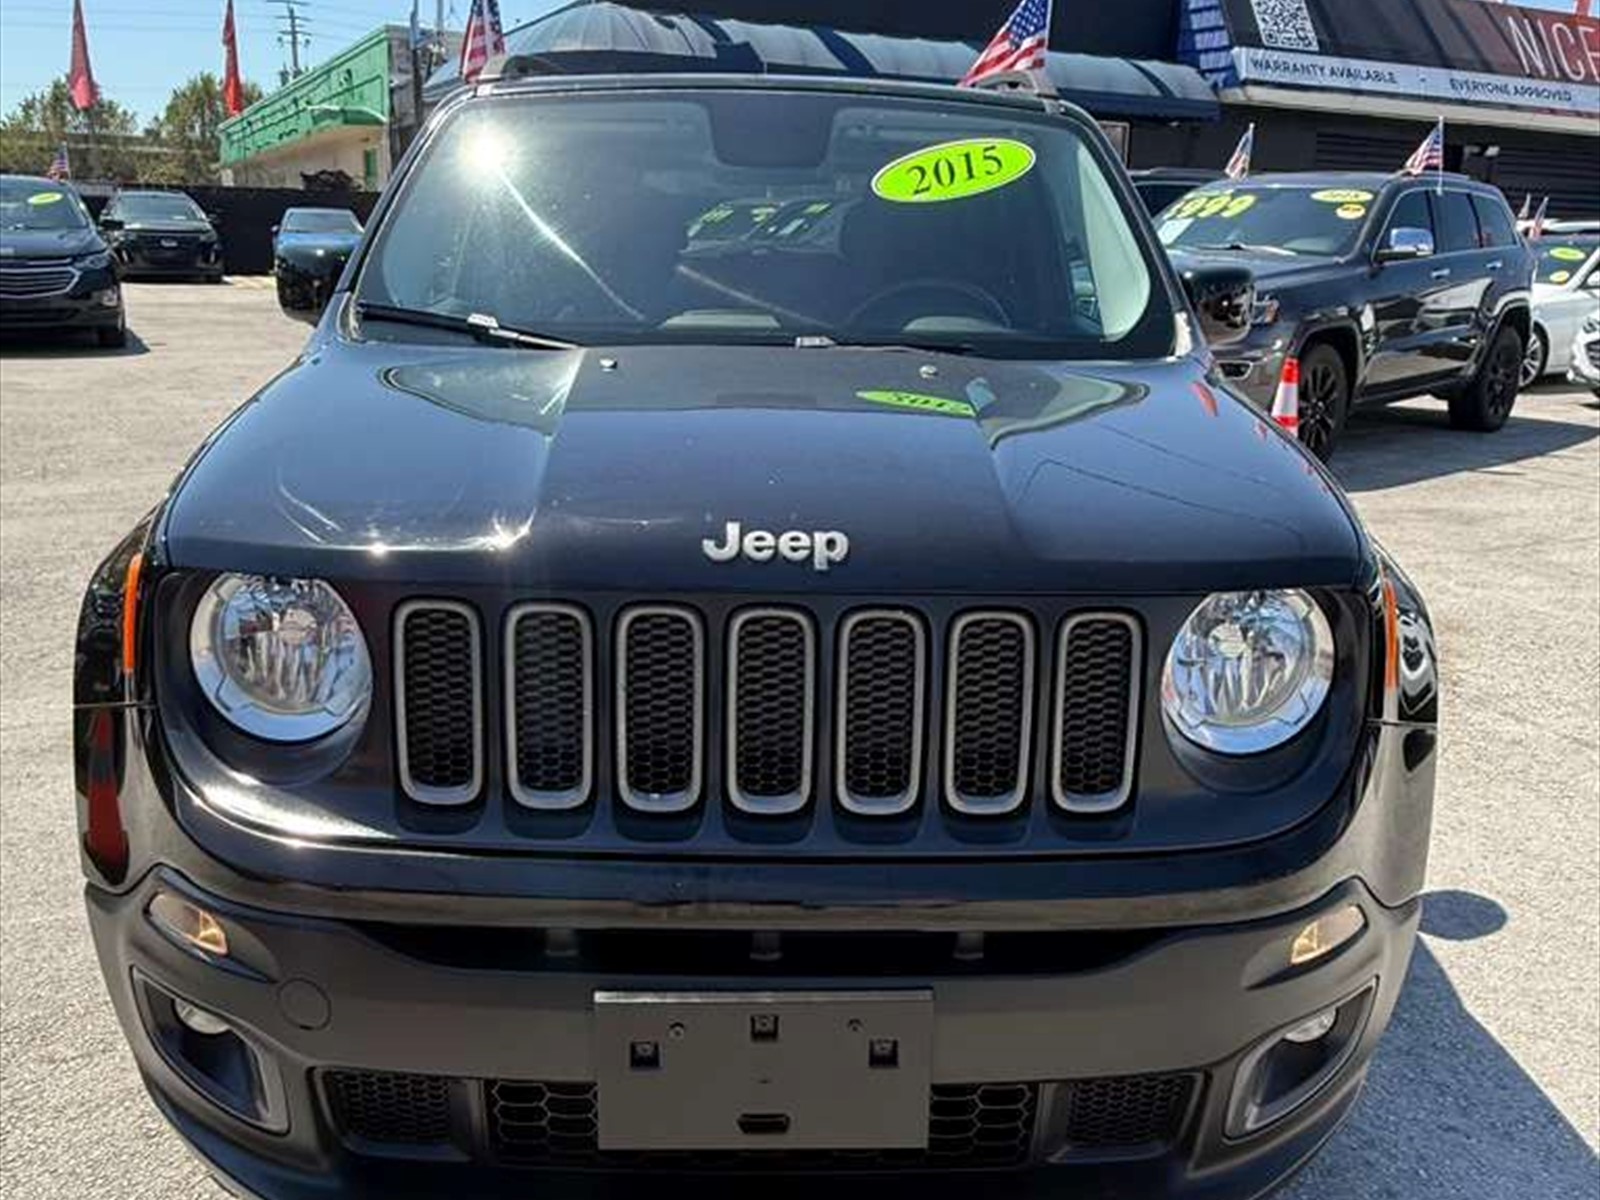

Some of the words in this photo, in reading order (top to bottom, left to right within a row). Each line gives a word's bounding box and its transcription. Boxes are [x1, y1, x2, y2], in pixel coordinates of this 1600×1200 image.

[1250, 58, 1325, 77] WARRANTY
[1329, 66, 1398, 84] AVAILABLE
[1450, 78, 1511, 96] EVERYONE
[1514, 85, 1572, 101] APPROVED
[906, 145, 1003, 195] 2015
[702, 521, 849, 570] Jeep
